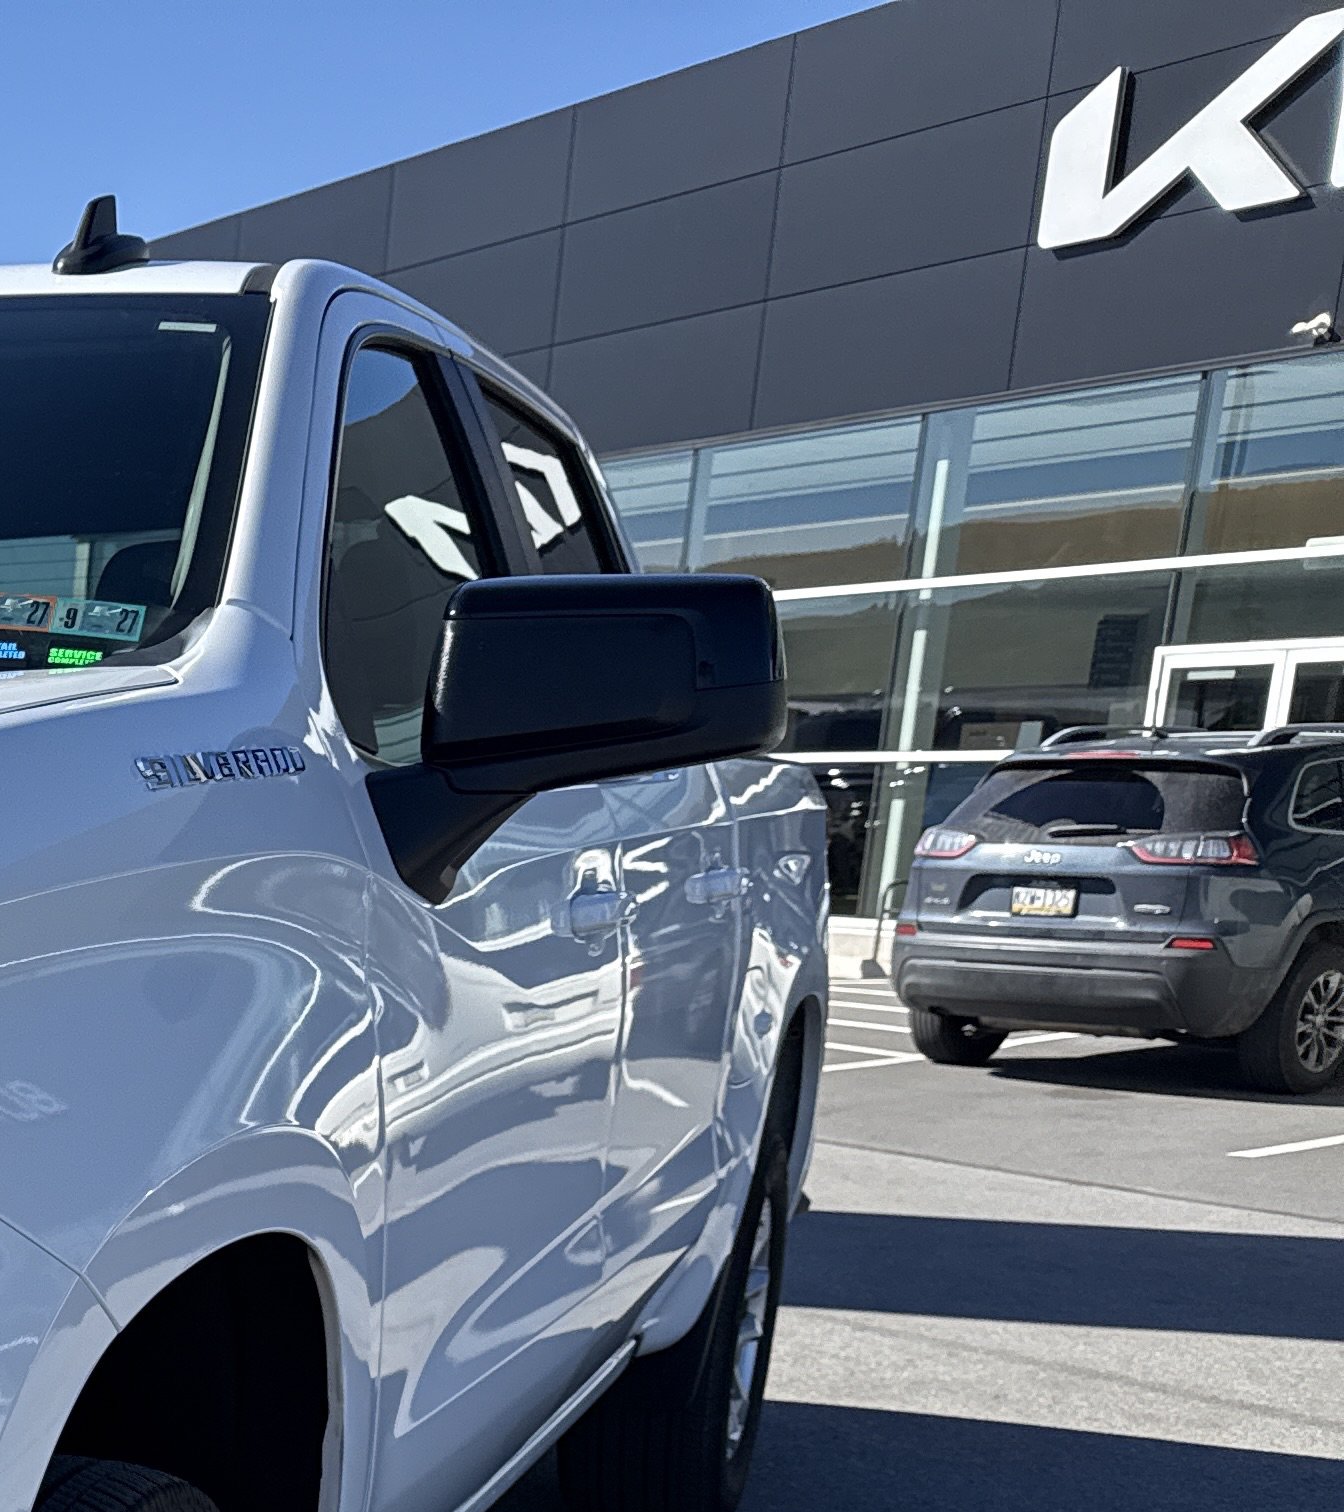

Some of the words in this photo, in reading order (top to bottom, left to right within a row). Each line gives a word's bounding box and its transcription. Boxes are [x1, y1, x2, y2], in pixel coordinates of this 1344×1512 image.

[26, 601, 51, 626] 27
[115, 608, 140, 634] 27
[48, 647, 104, 661] SERVICE
[133, 746, 306, 791] SILVERADO
[1023, 849, 1062, 865] Jeep
